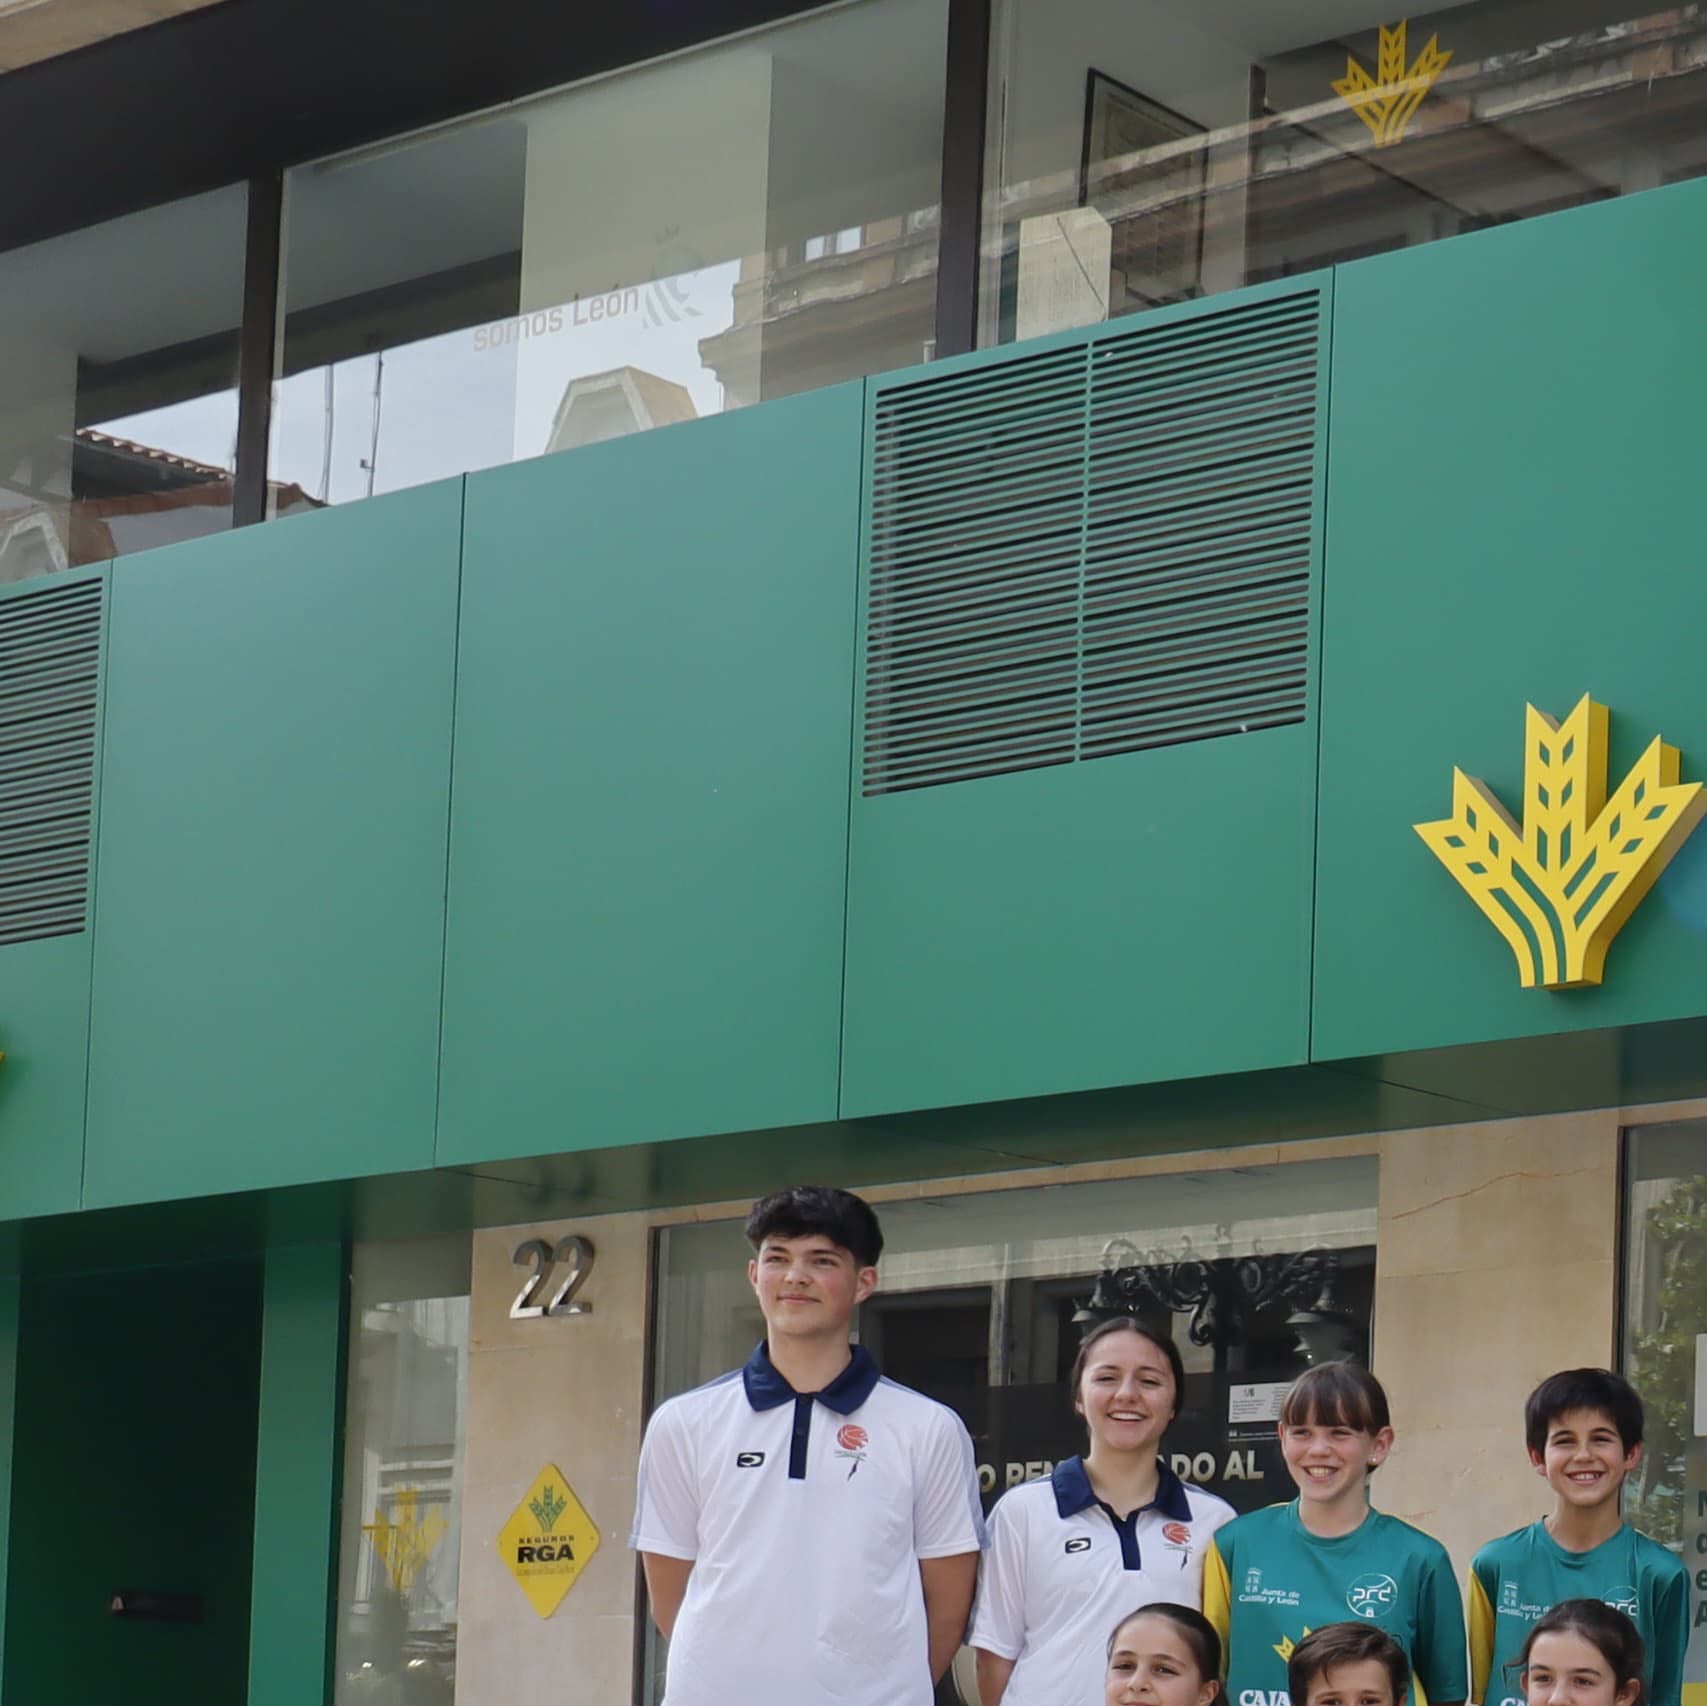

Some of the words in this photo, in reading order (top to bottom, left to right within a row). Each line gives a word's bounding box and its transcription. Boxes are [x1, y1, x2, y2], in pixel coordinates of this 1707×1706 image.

[508, 1234, 595, 1319] 22
[1223, 1451, 1265, 1480] AL
[519, 1535, 575, 1544] SEGUROS
[517, 1544, 574, 1563] RGA
